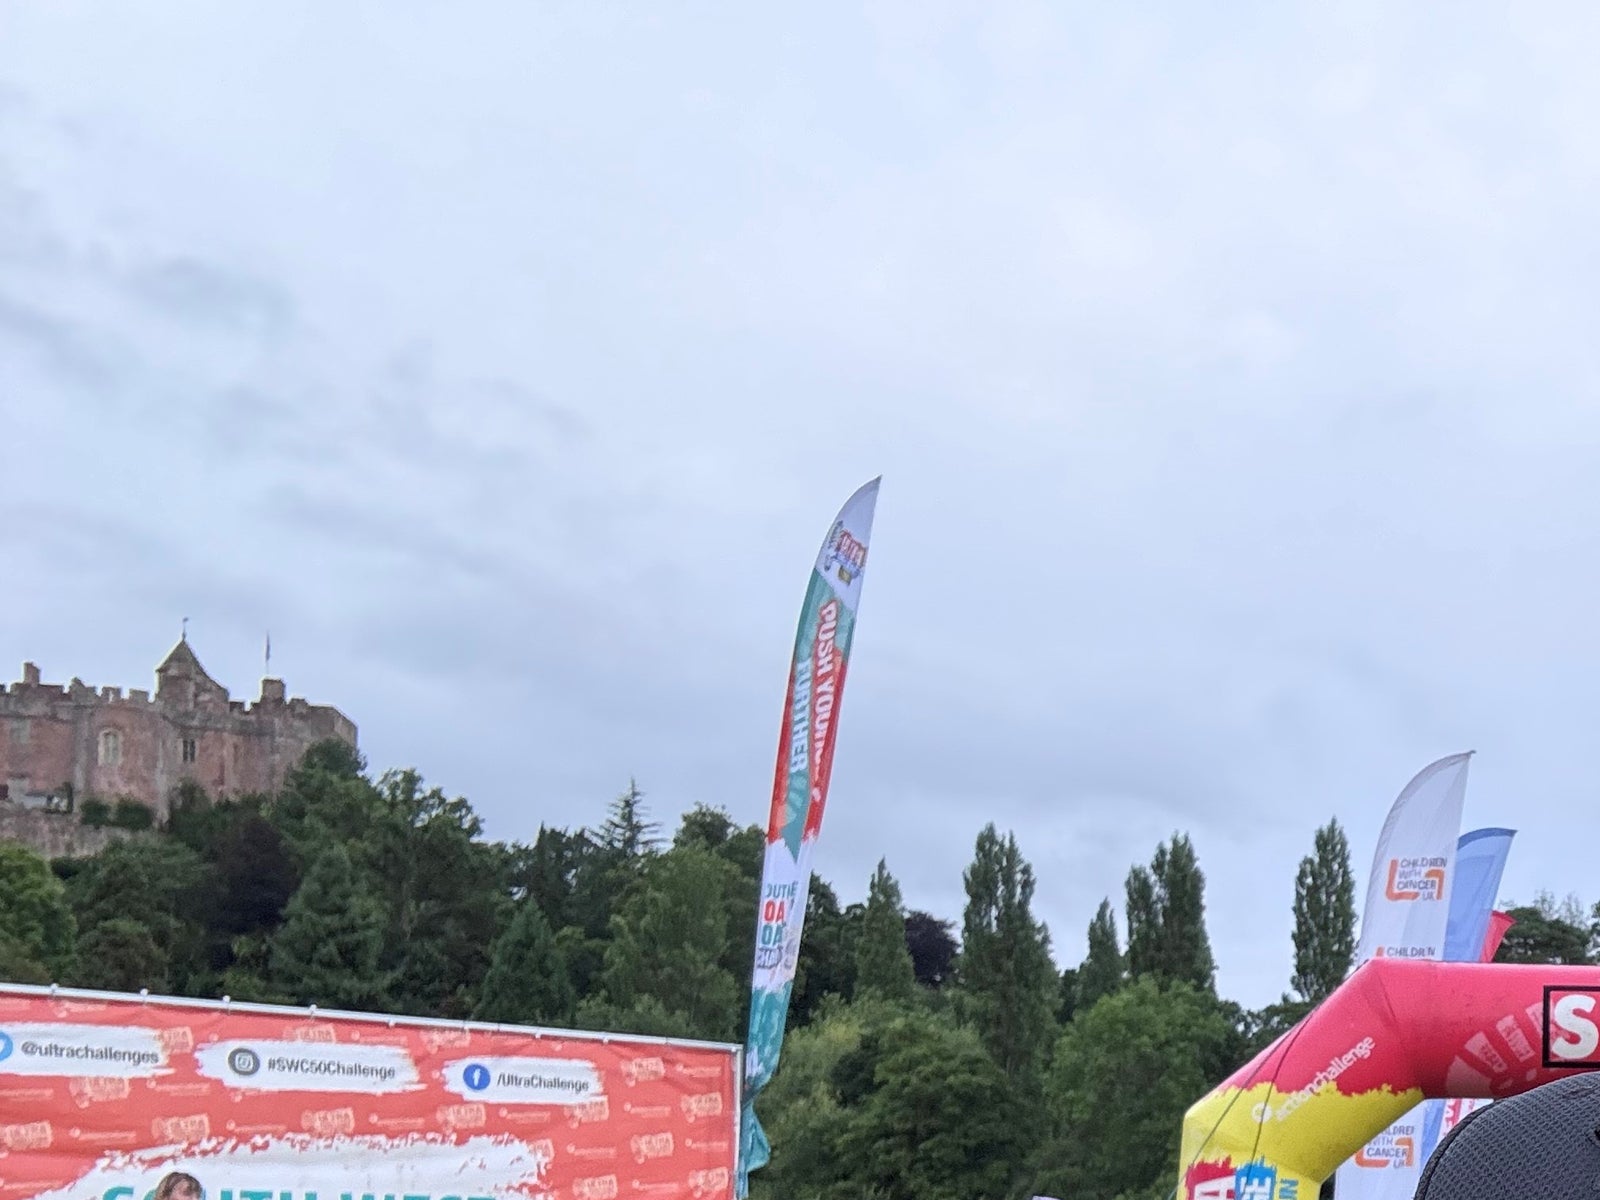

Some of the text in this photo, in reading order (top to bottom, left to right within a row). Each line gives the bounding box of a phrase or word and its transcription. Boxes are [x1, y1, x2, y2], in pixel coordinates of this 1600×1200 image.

[1400, 857, 1448, 868] CHILDREN
[1398, 869, 1422, 879] WITH
[1396, 880, 1437, 890] CANCER
[21, 1040, 160, 1066] @ultrachallenges
[267, 1056, 396, 1080] #SWC50Challenge
[496, 1073, 590, 1092] /UltraChallenge
[1275, 1036, 1376, 1121] actionchallenge
